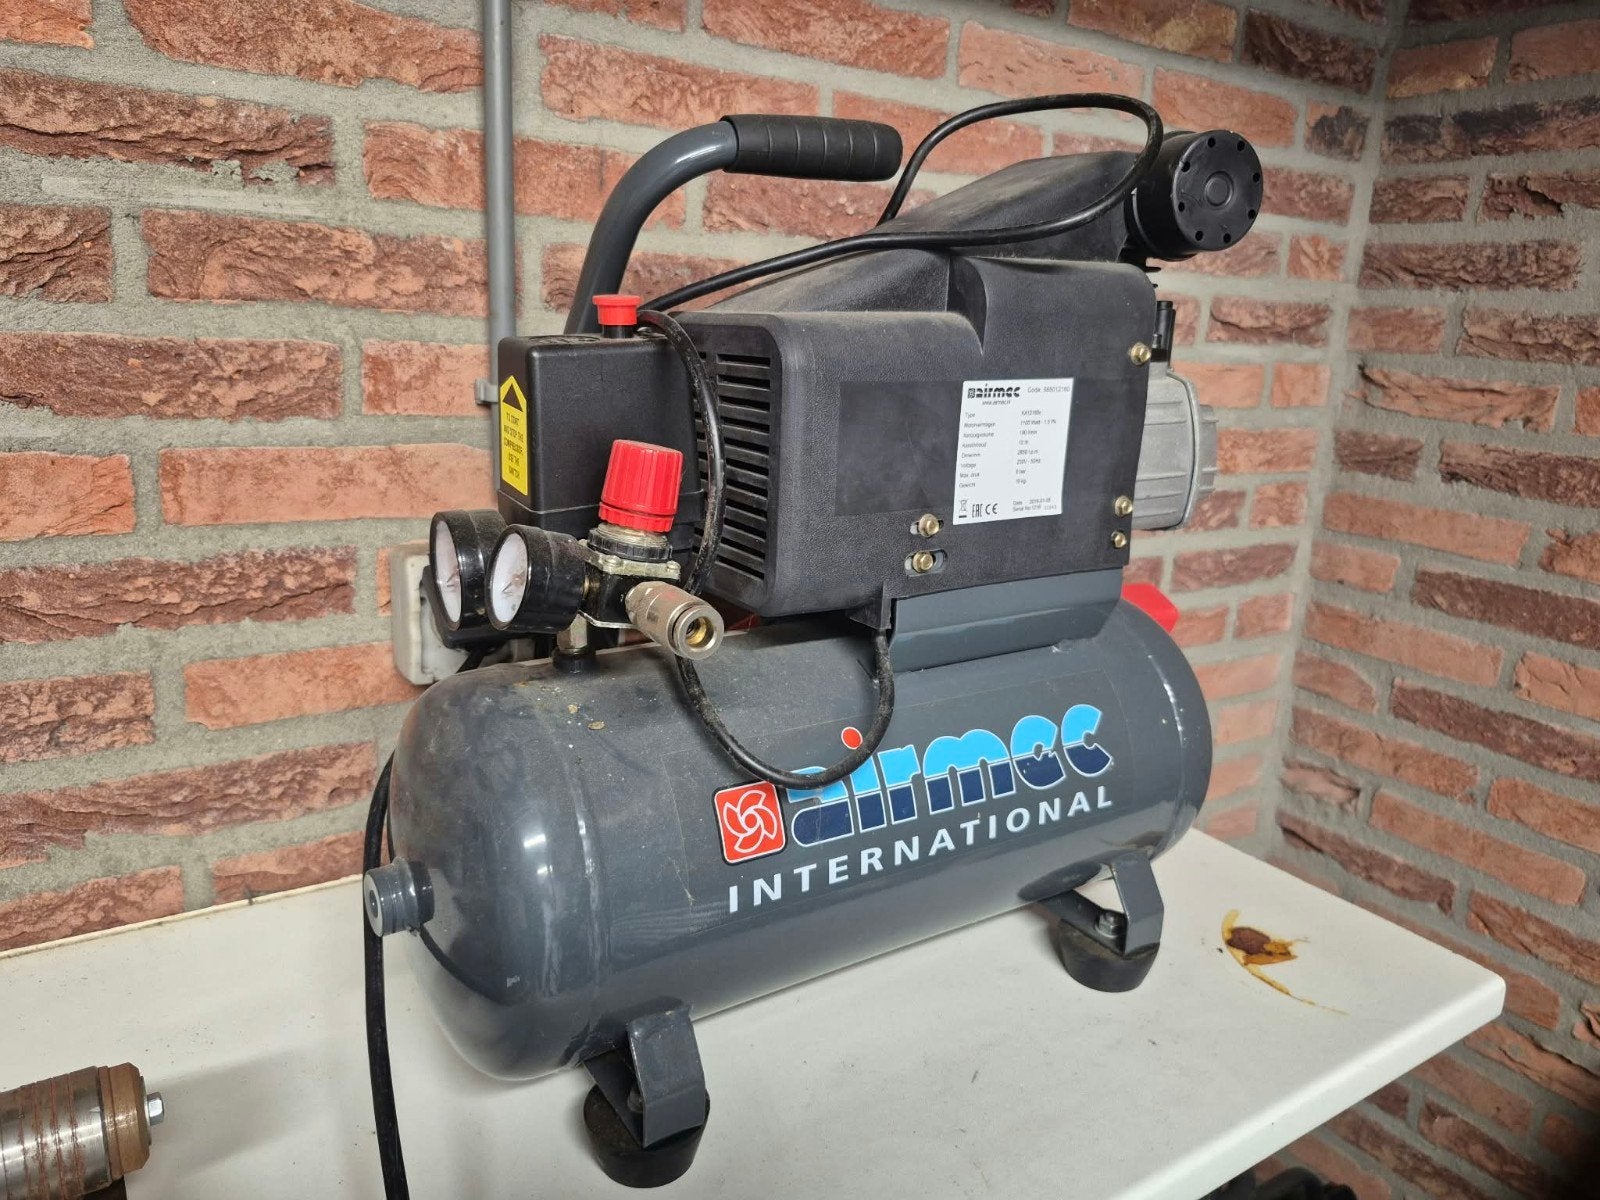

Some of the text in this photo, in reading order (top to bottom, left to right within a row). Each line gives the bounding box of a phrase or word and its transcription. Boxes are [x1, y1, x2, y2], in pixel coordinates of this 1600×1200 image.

[976, 383, 1020, 398] airmec
[786, 703, 1113, 848] airmec
[729, 785, 1113, 914] INTERNATIONAL
